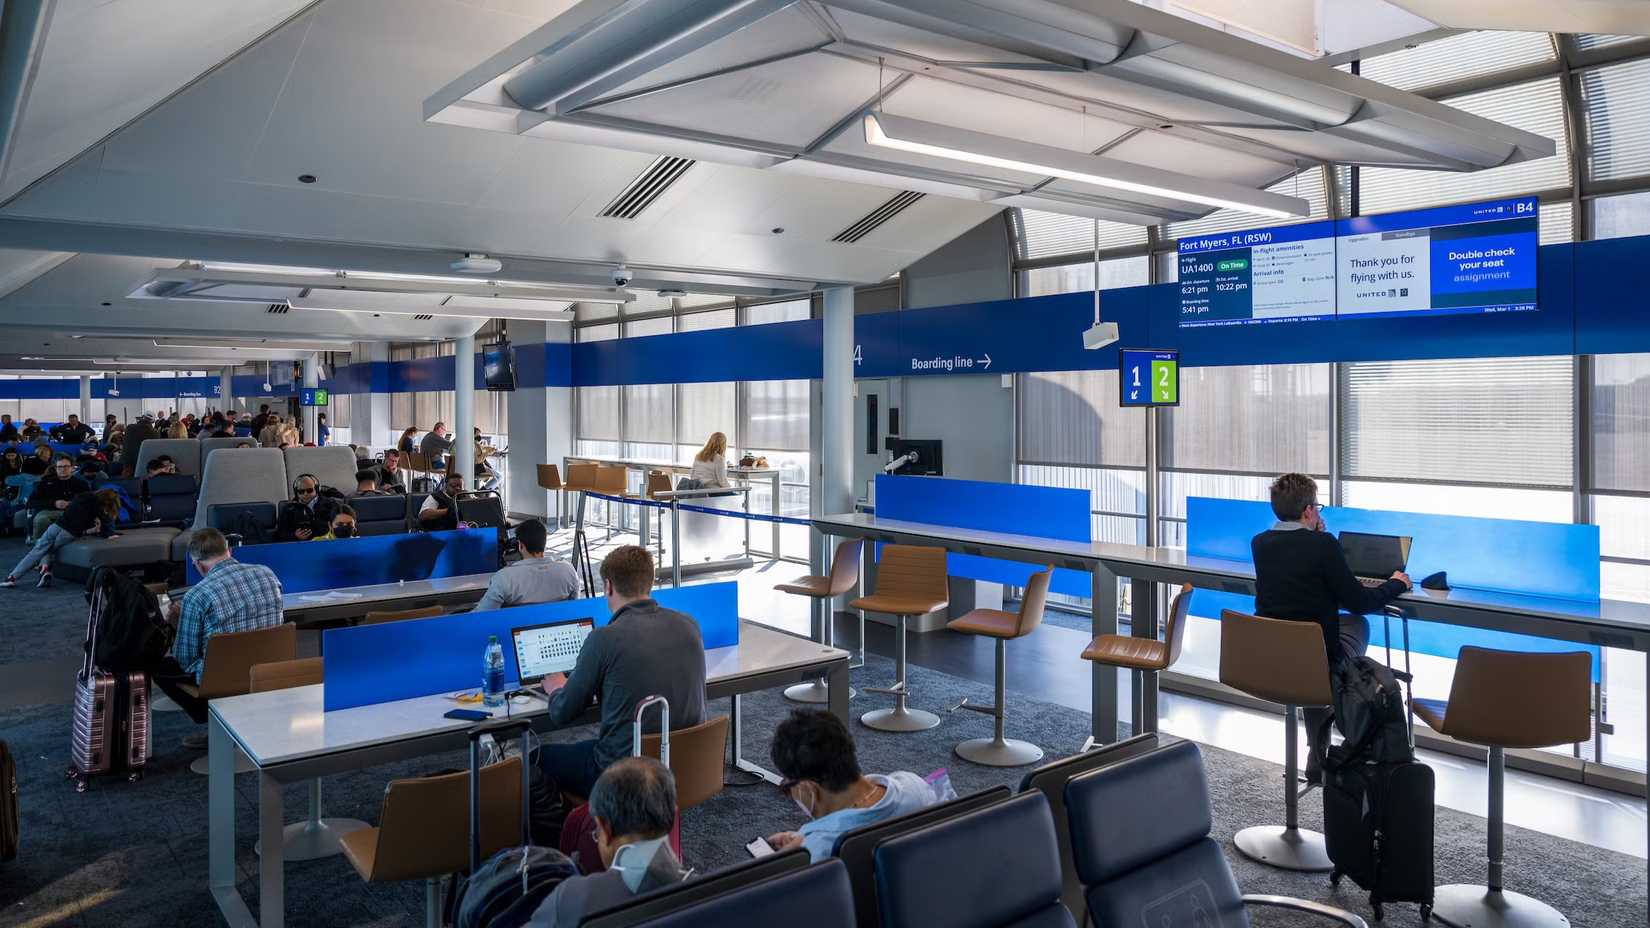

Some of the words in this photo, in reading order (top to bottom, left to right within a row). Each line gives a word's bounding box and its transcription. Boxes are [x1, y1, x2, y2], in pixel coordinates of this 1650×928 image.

[1517, 203, 1533, 213] B4
[1180, 242, 1198, 250] Fort
[1200, 239, 1230, 249] Myers,
[1232, 236, 1242, 244] FL
[1244, 232, 1272, 245] (RSW)
[1449, 251, 1483, 260] Double
[1484, 247, 1515, 258] check
[1350, 258, 1378, 268] Thank
[1380, 257, 1398, 268] you
[1400, 255, 1415, 264] for
[1460, 261, 1481, 271] your
[1482, 259, 1504, 268] seat
[1182, 263, 1213, 273] UA1400
[1351, 273, 1376, 284] flying
[1377, 270, 1398, 280] with
[1401, 271, 1415, 279] us.
[1454, 271, 1510, 283] assignment
[1182, 286, 1195, 294] 6:21
[1197, 286, 1208, 295] pm
[1216, 283, 1234, 291] 10:22
[1235, 283, 1248, 292] pm
[1197, 306, 1209, 314] pm
[911, 356, 953, 371] Boarding
[954, 355, 973, 368] line
[1132, 366, 1141, 387] 1
[1159, 366, 1169, 387] 2
